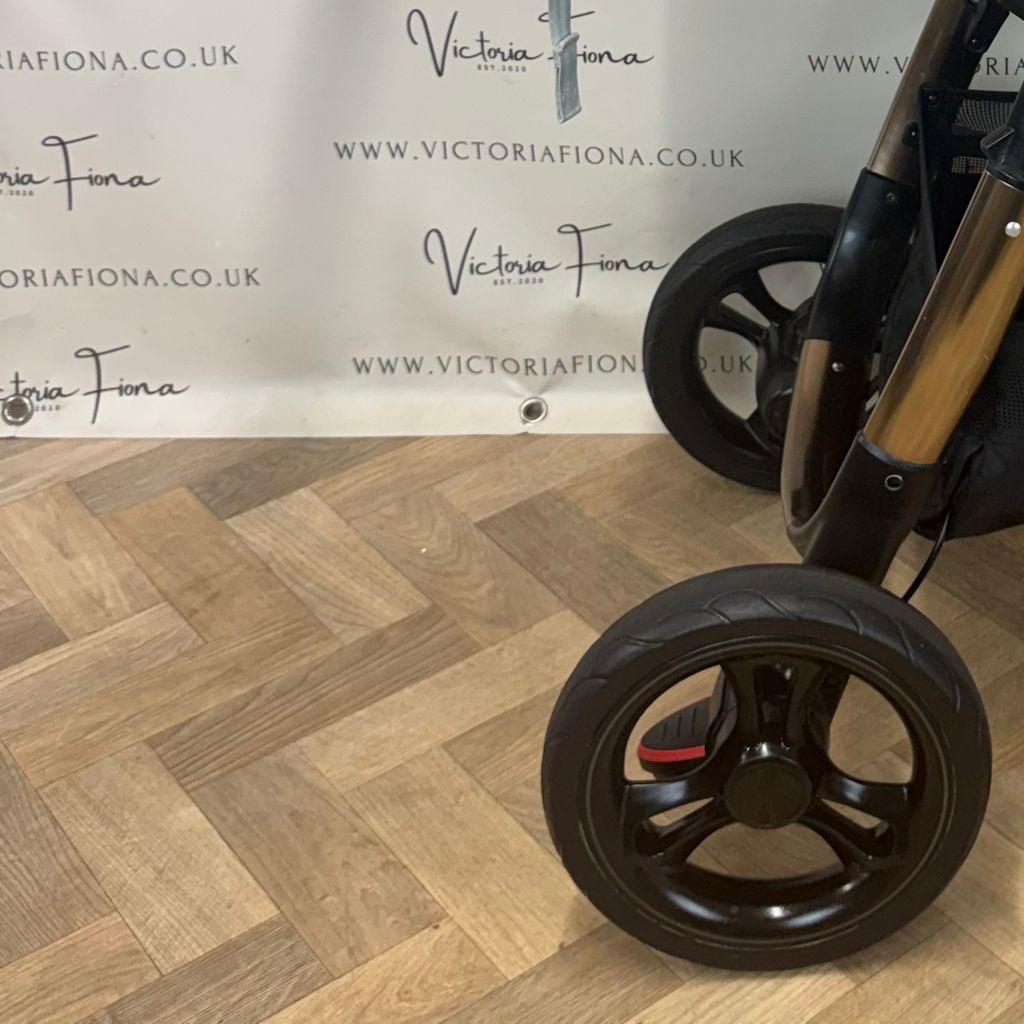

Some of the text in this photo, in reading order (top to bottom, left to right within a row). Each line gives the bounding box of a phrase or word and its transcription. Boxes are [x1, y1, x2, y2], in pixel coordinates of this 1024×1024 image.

[406, 9, 543, 77] Victoria
[40, 134, 160, 211] Fiona
[334, 141, 744, 167] WWW.VICTORIAFIONA.CO.UK
[423, 223, 667, 297] Victoria Fiona
[82, 345, 190, 424] Fiona
[352, 355, 752, 378] WWW.VICTORIAFION.UK
